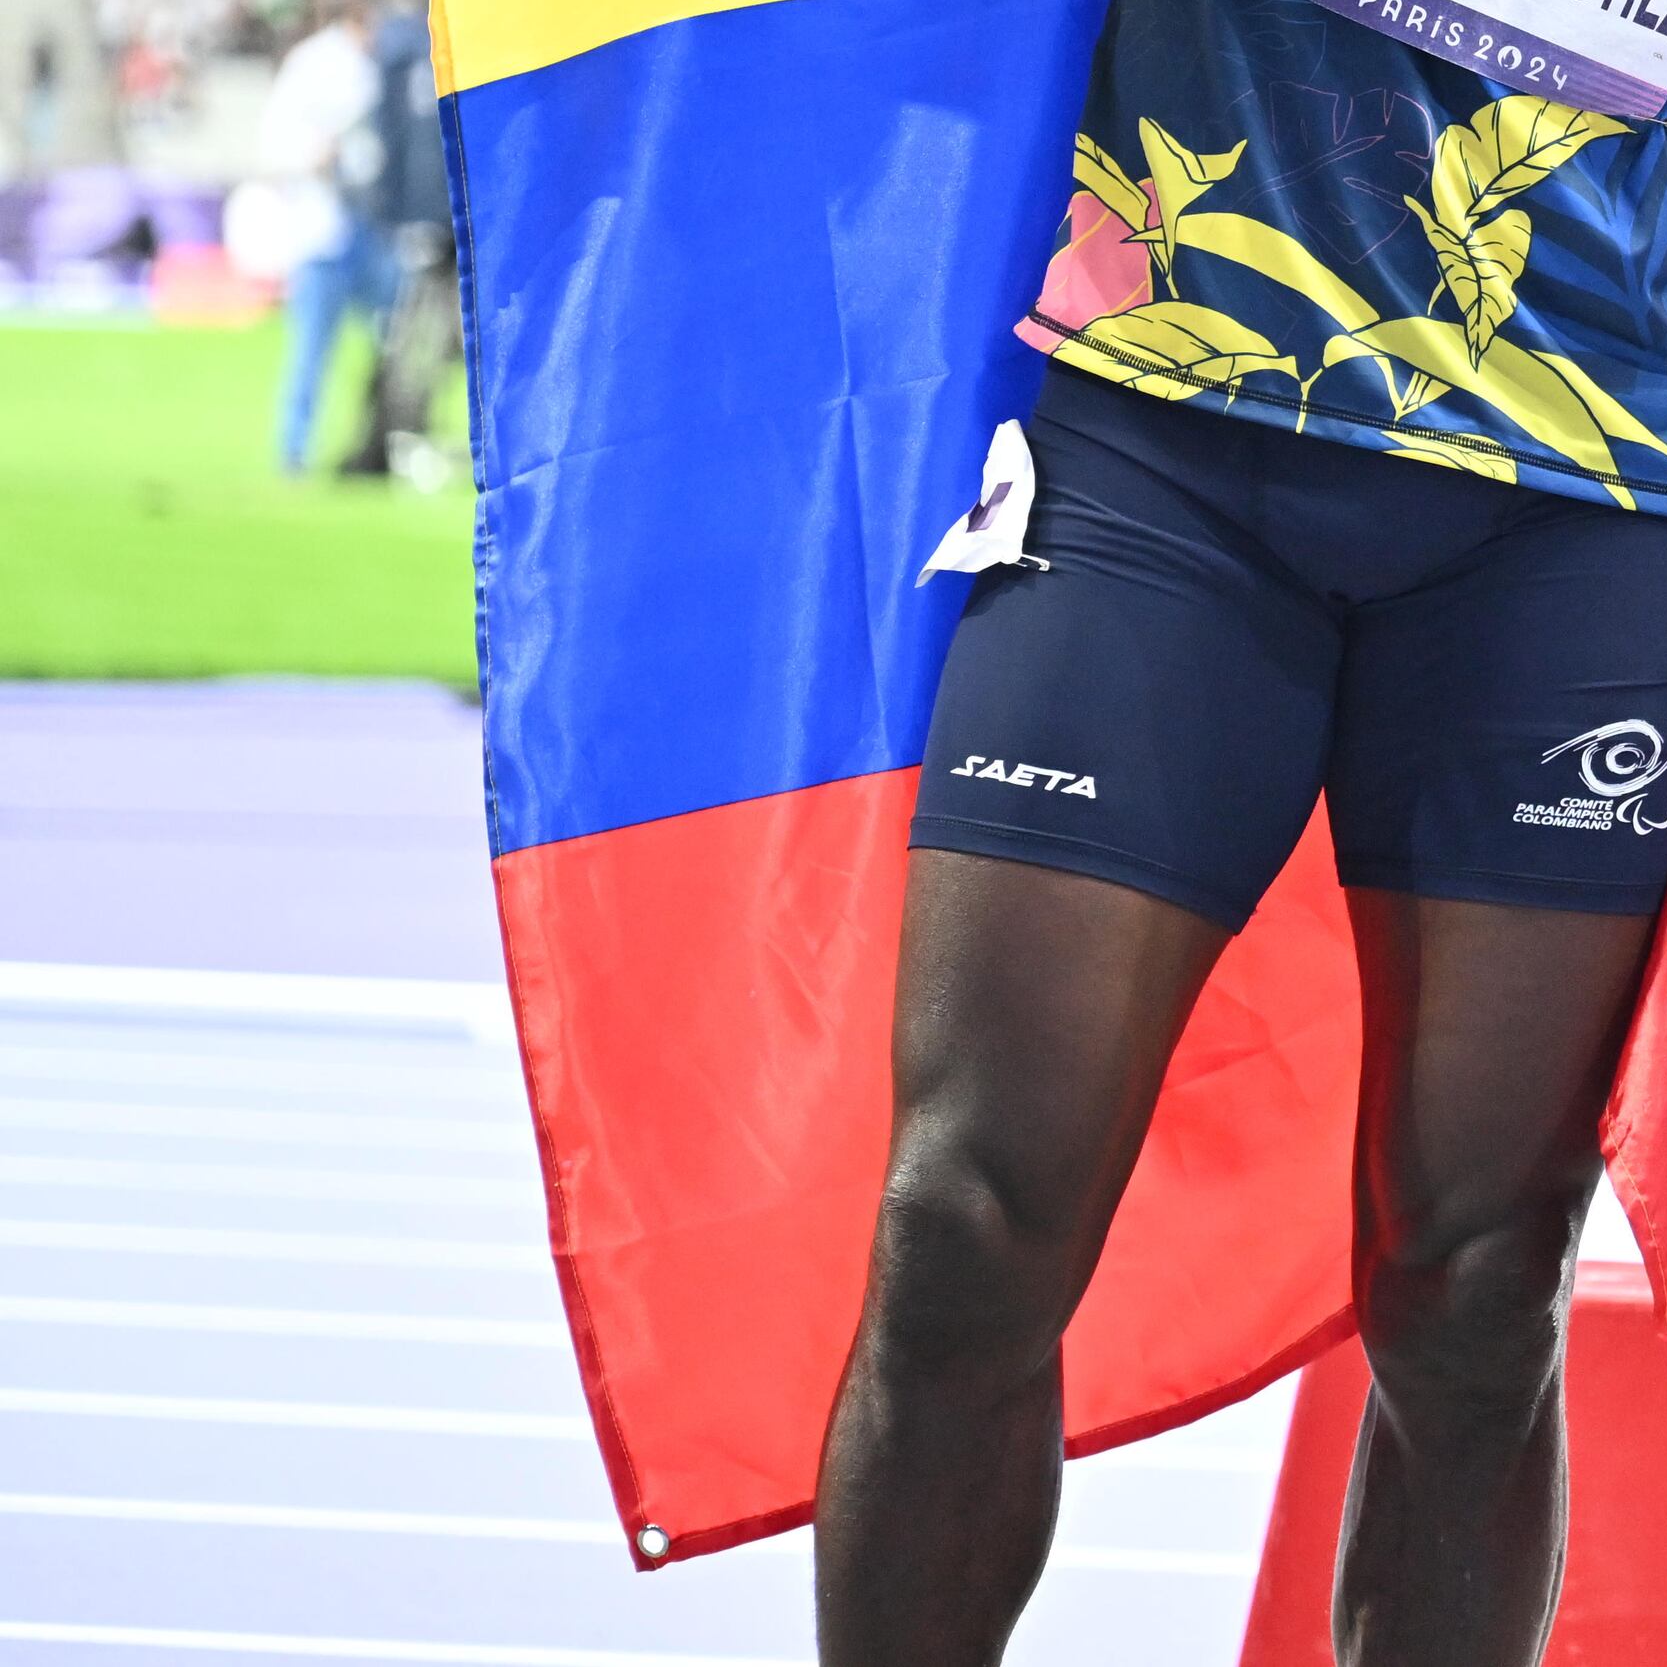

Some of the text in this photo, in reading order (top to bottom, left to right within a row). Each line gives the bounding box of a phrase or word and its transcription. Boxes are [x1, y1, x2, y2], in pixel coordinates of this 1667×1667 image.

[1474, 34, 1568, 90] 2024
[950, 755, 1096, 799] SAETA
[1515, 802, 1614, 821] PARALÍMPICO
[1560, 797, 1614, 811] COMITÉ
[1512, 813, 1612, 831] COLOMBIANO
